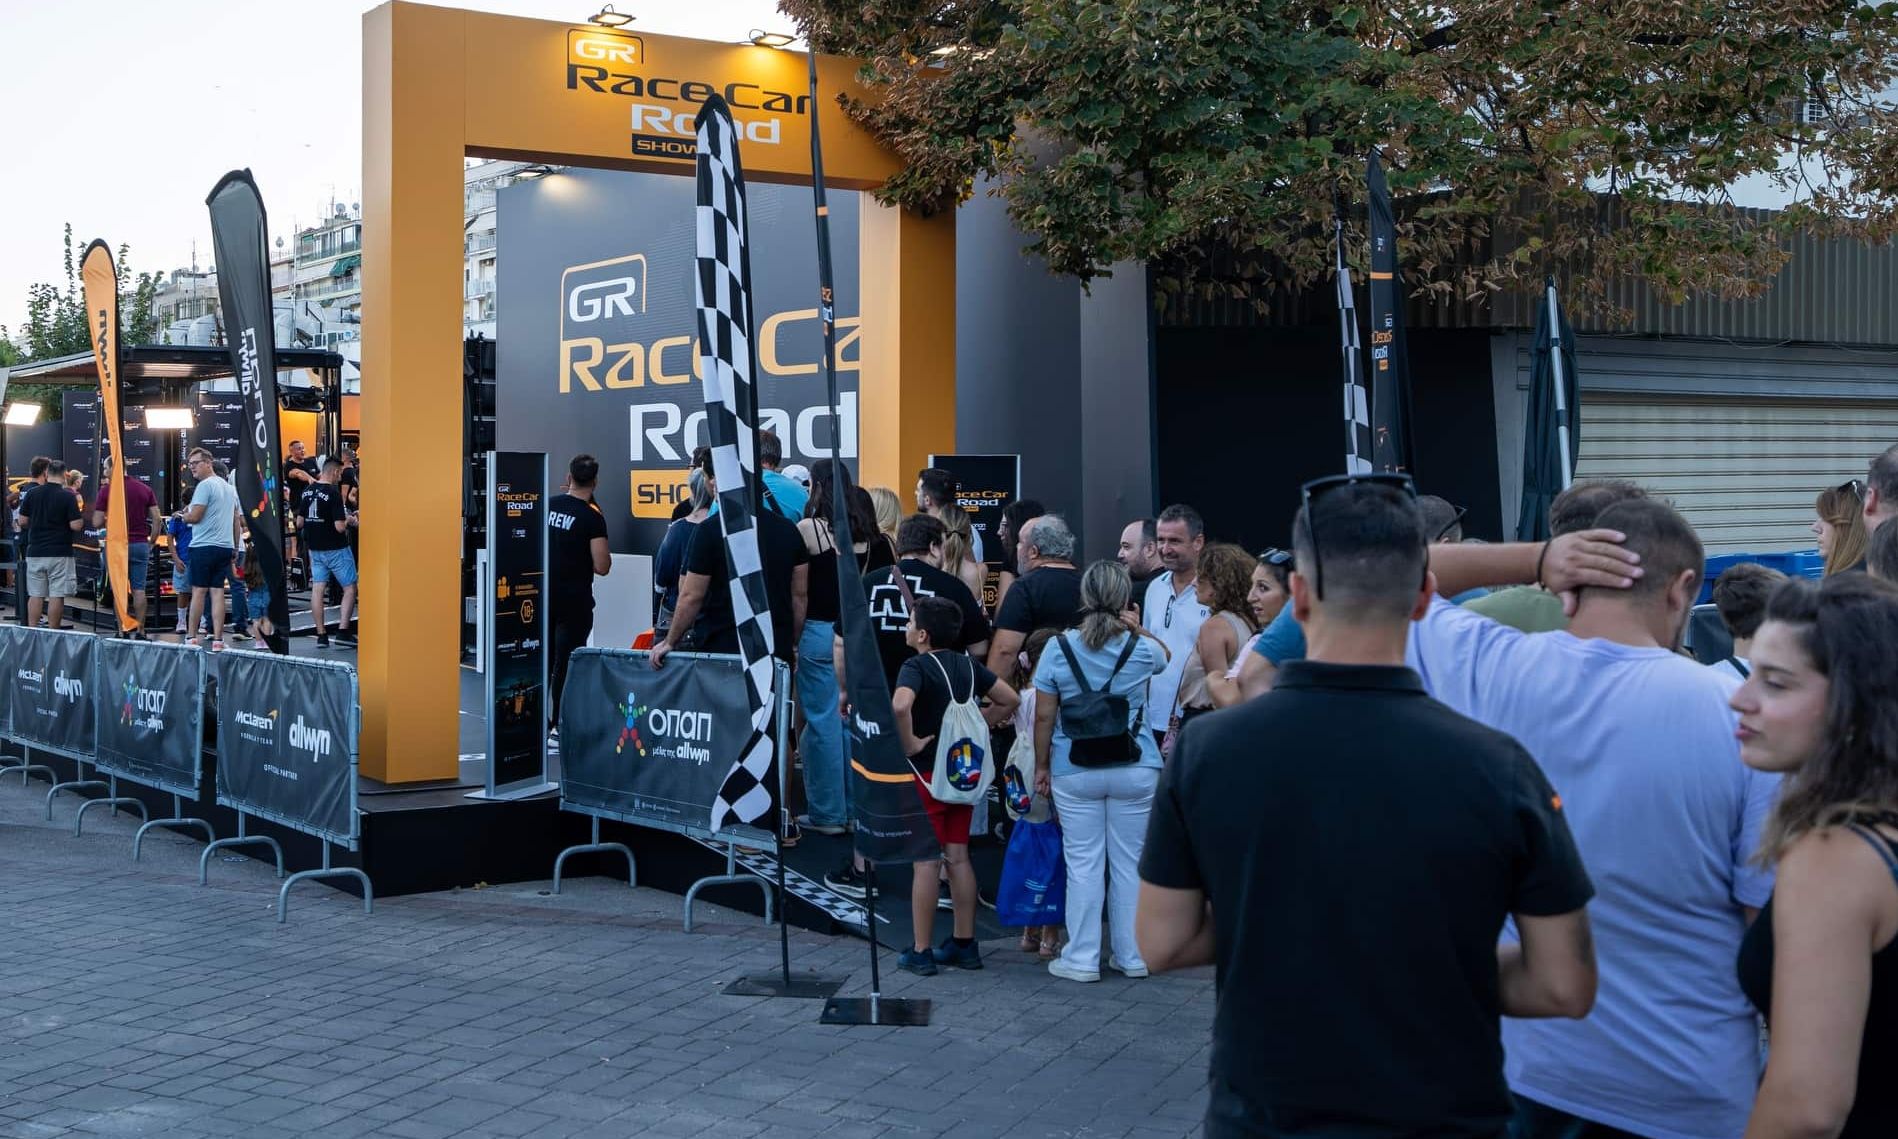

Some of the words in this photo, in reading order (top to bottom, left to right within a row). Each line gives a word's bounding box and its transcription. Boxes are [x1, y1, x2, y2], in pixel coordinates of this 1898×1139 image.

[575, 38, 635, 64] GR
[567, 64, 715, 104] Race
[725, 83, 812, 115] Car
[569, 276, 636, 323] GR
[759, 308, 861, 376] Ca
[497, 493, 522, 501] Race
[638, 484, 689, 504] SHO
[982, 490, 1008, 498] Car
[507, 502, 533, 510] Road
[548, 510, 576, 531] REW
[523, 606, 535, 618] 18+
[235, 711, 272, 730] McLaren
[289, 714, 331, 763] allwyn
[677, 742, 710, 766] allwyn
